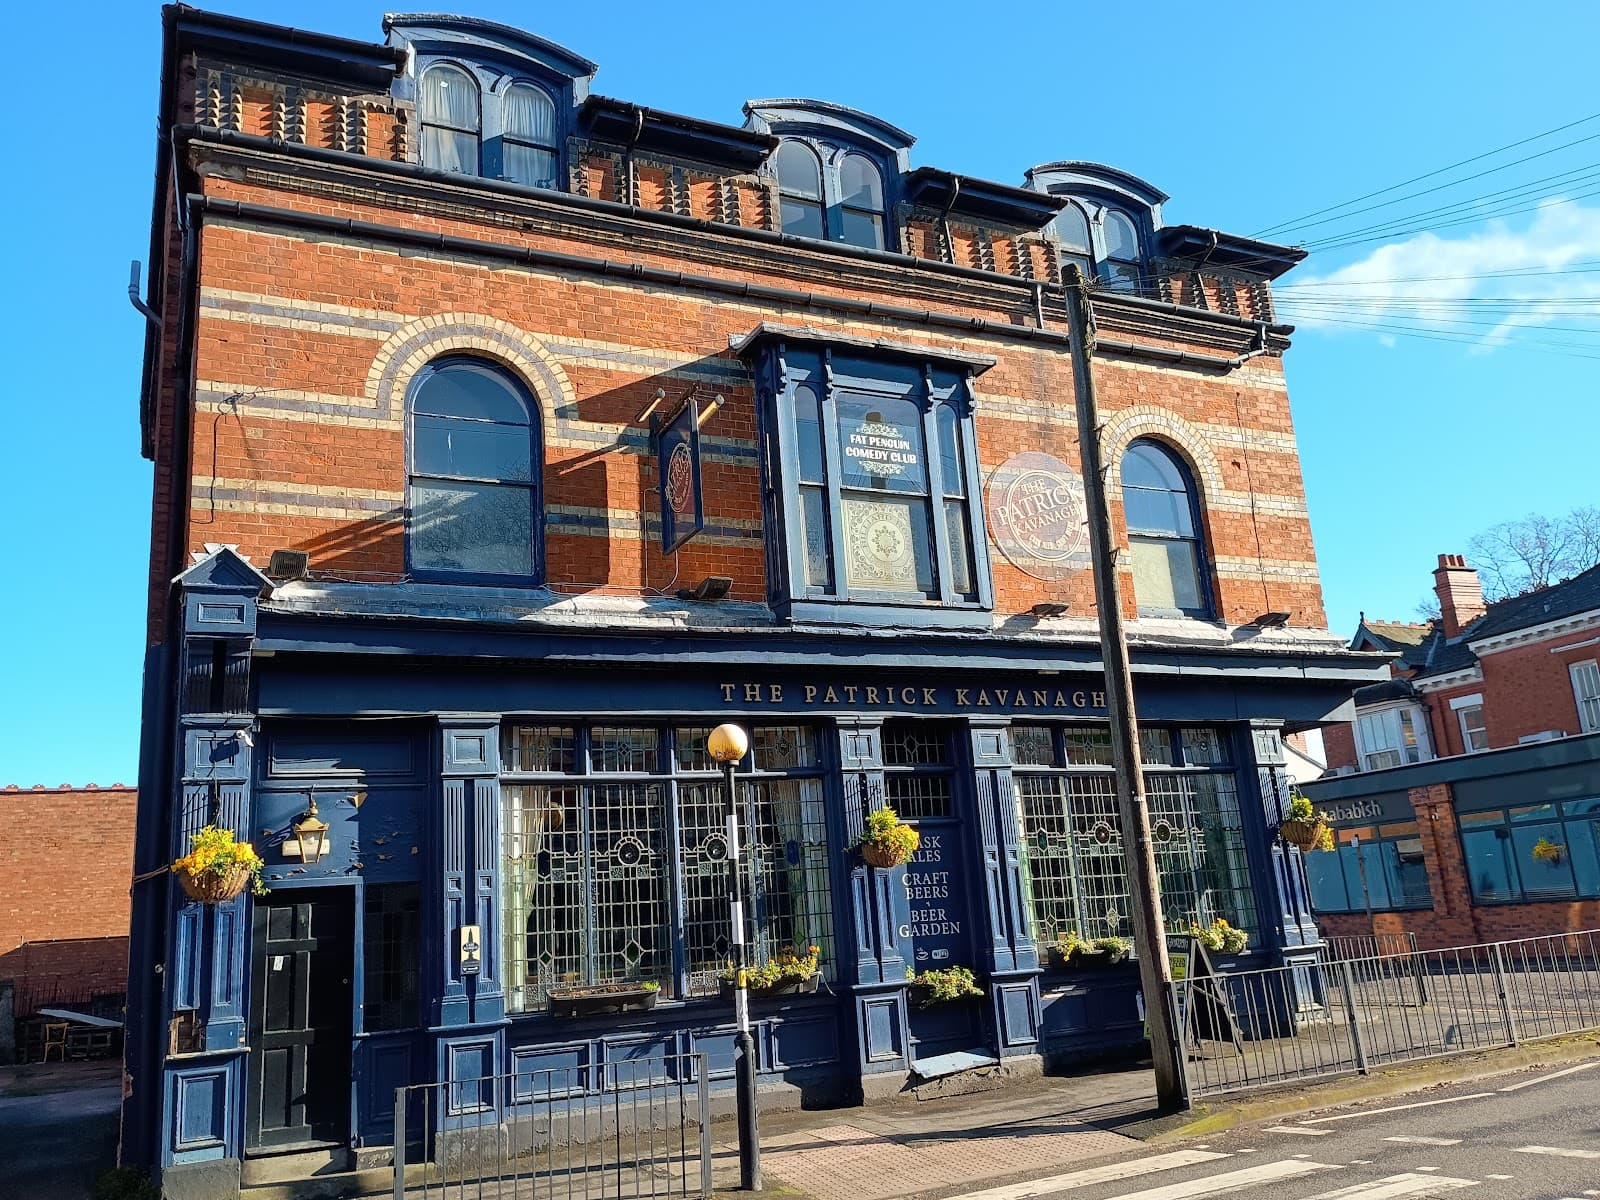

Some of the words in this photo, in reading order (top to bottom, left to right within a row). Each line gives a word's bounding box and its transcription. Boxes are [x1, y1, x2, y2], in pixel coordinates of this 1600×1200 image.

[850, 434, 869, 445] FAT
[845, 447, 889, 461] COMEDY
[890, 452, 917, 464] CLUB
[1021, 478, 1048, 496] THE
[995, 480, 1082, 526] PATRICK
[1013, 502, 1082, 536] KAVANAGH
[720, 683, 783, 702] THE
[804, 685, 937, 705] PATRICK
[956, 688, 1107, 708] KAVANAGH
[919, 836, 942, 849] SK
[909, 850, 941, 863] ALES
[902, 871, 949, 886] CRAFT
[905, 885, 949, 900] BEERS
[911, 908, 948, 922] BEER
[899, 921, 960, 937] GARDEN
